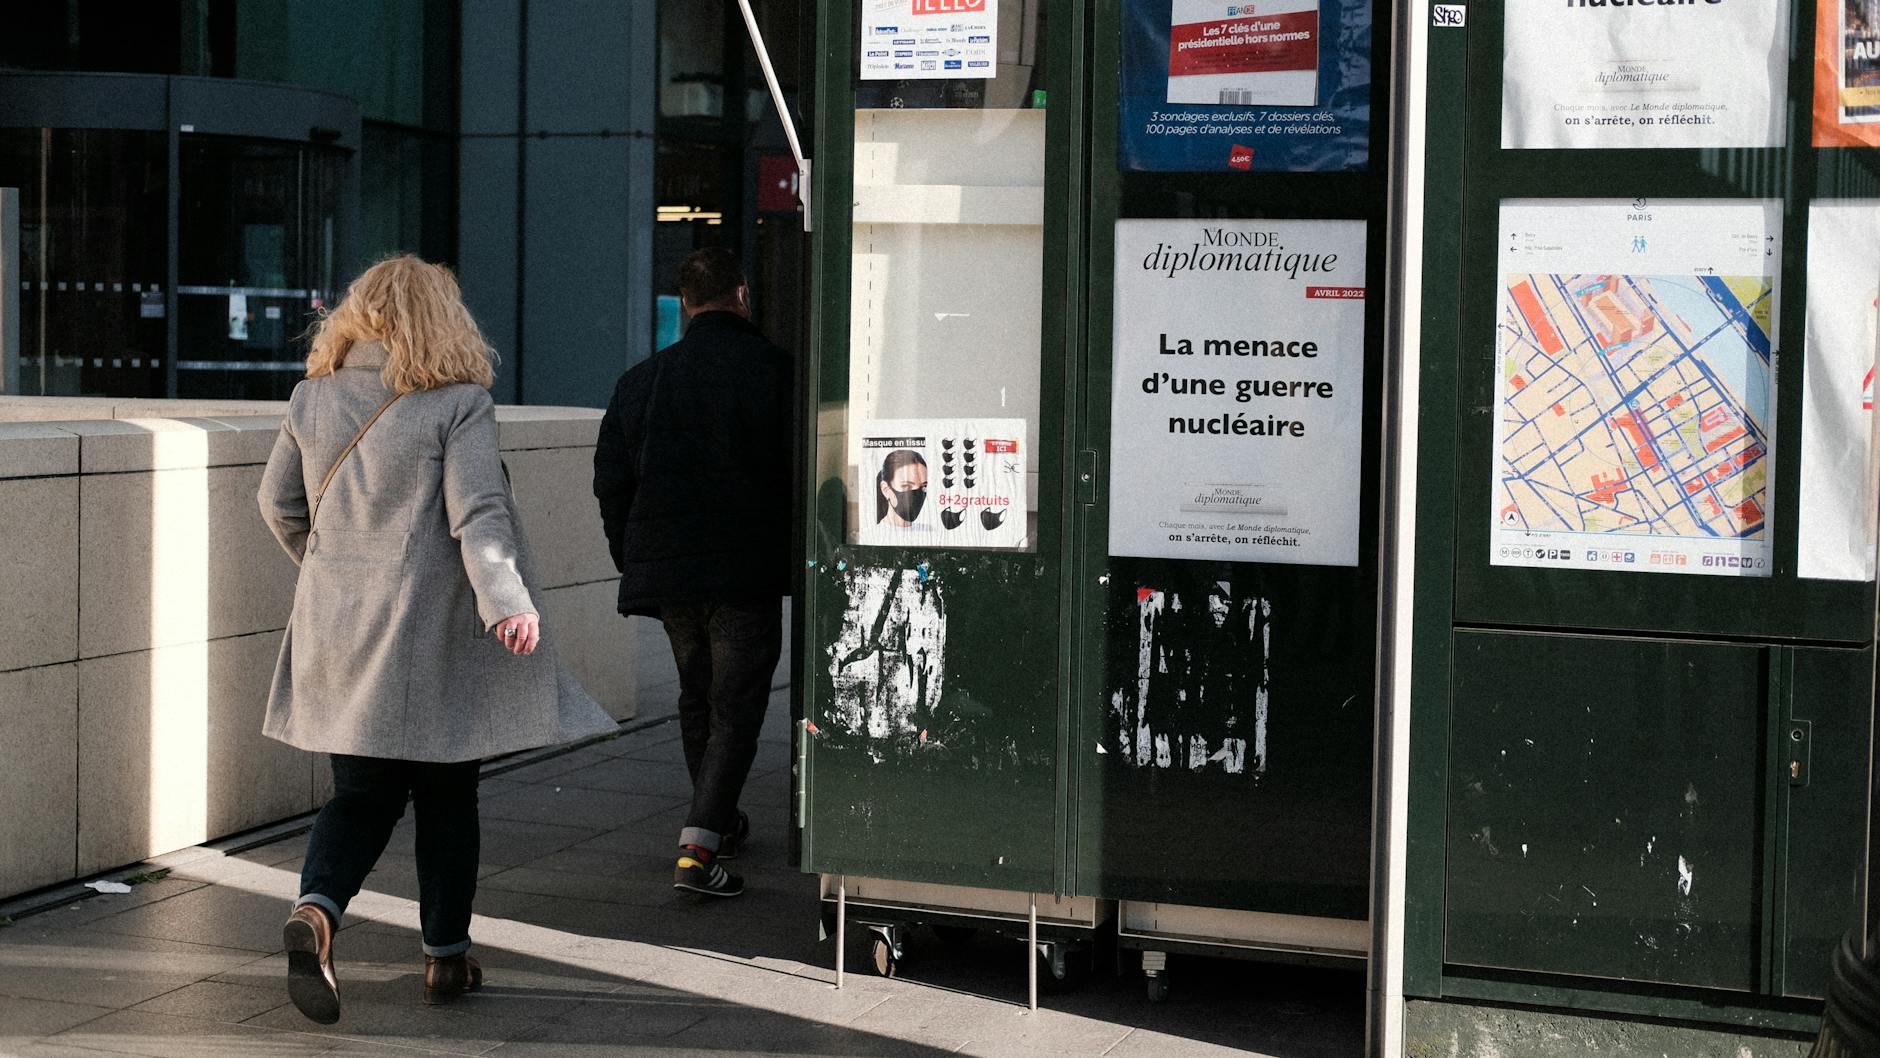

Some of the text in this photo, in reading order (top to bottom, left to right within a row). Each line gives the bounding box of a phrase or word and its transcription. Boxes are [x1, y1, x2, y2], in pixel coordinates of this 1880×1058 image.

[1203, 21, 1281, 36] Les 7 clés d'une
[1178, 30, 1310, 51] présidentielle hors normes
[1617, 65, 1647, 73] MONDE
[1594, 71, 1669, 86] diplomatique
[1671, 103, 1728, 112] diplomatique,
[1150, 111, 1335, 122] 3 sondages exclusifs, 7 dossiers clés,
[1565, 115, 1715, 126] on s'arrête, on réfléchit.
[1145, 124, 1342, 135] 100 pages d'analyses et de révélations
[1202, 228, 1280, 247] MONDE
[1143, 243, 1337, 279] diplomatique
[1314, 289, 1364, 298] AVRIL 2022
[1159, 333, 1318, 358] La menace
[1142, 372, 1334, 403] d'une guerre
[1169, 412, 1305, 438] nucléaire
[862, 438, 894, 448] Masque
[905, 438, 926, 447] tissu
[1214, 488, 1241, 496] MONDE
[939, 494, 1010, 508] 8+2gratuits
[1194, 493, 1262, 507] diplomatique
[1158, 521, 1186, 530] Chaque
[1226, 523, 1235, 531] Le
[1237, 524, 1262, 532] Monde
[1263, 525, 1311, 535] diplomatique,
[1168, 533, 1301, 547] on s'arrête, on réfléchit.
